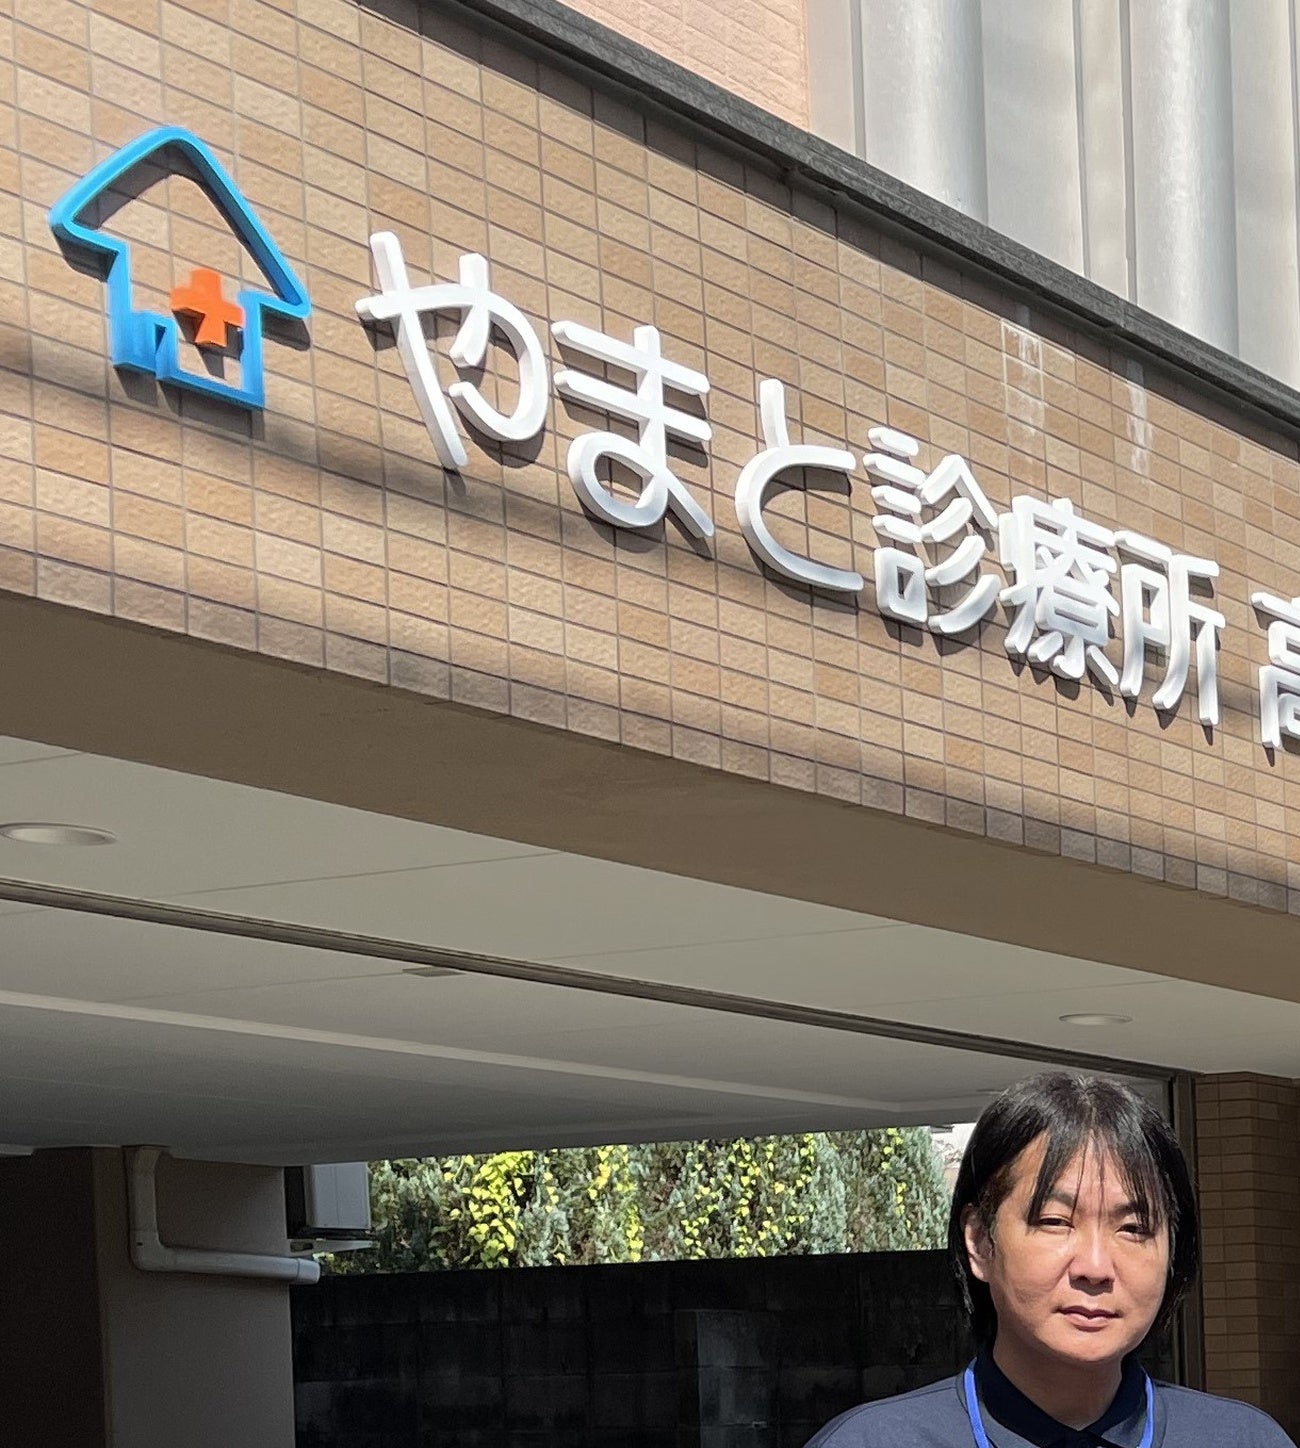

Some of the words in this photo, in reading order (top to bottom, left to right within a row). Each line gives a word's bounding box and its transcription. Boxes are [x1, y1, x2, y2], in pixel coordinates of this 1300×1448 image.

[355, 231, 1225, 727] やまと診療所
